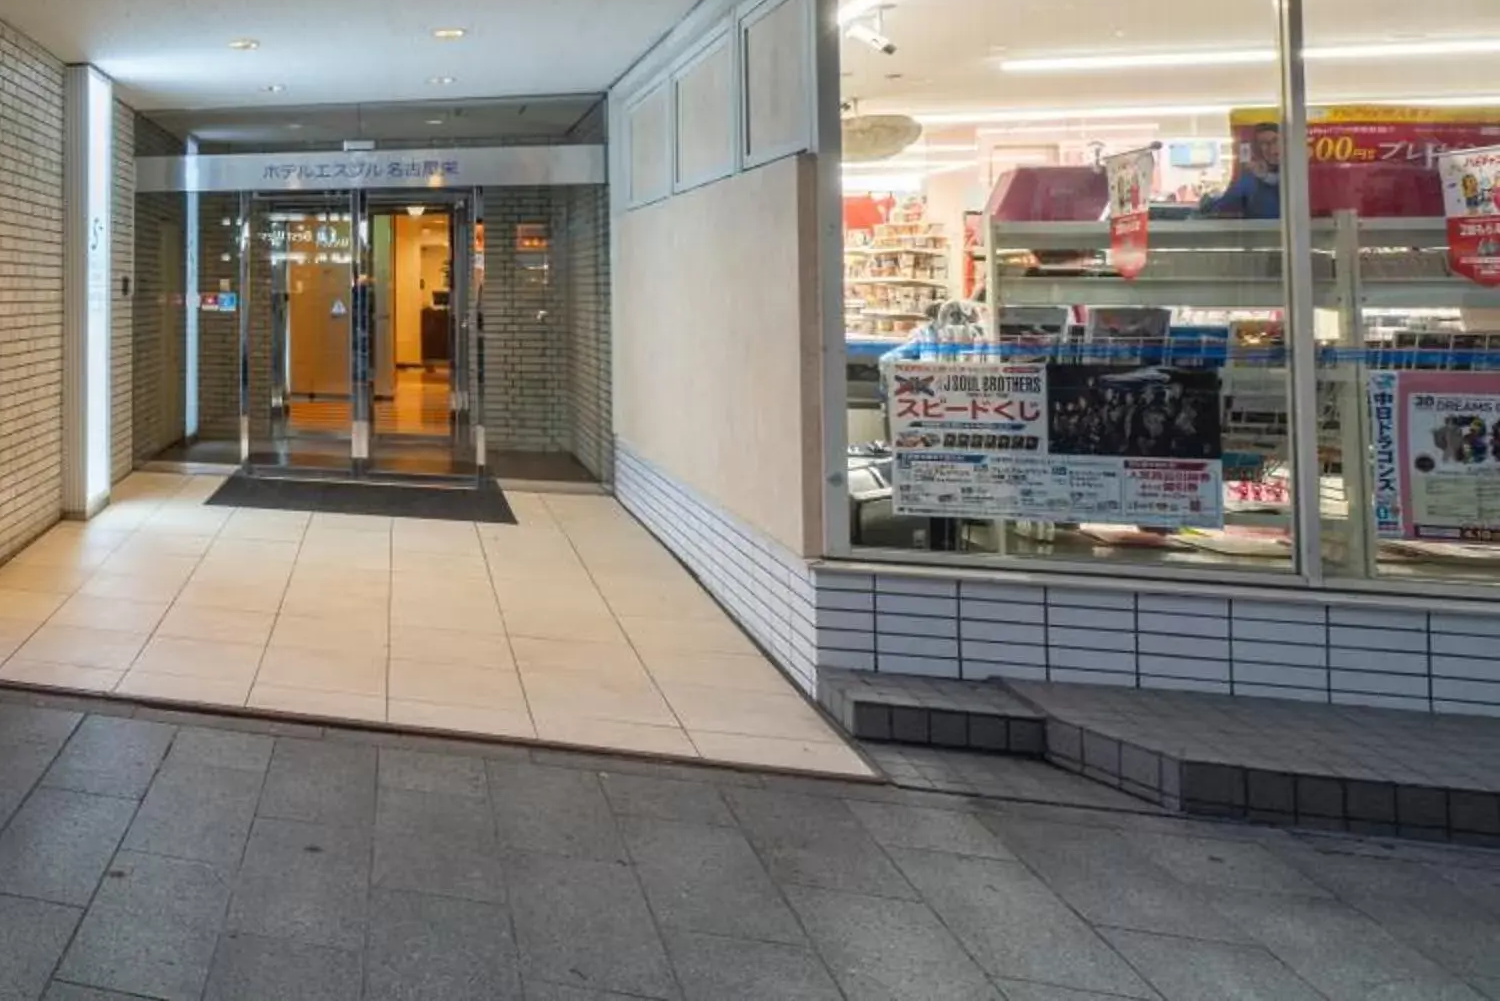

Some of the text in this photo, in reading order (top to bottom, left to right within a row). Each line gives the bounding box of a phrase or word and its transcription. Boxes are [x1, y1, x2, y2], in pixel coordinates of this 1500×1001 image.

[262, 163, 381, 180] ホテルエスプル
